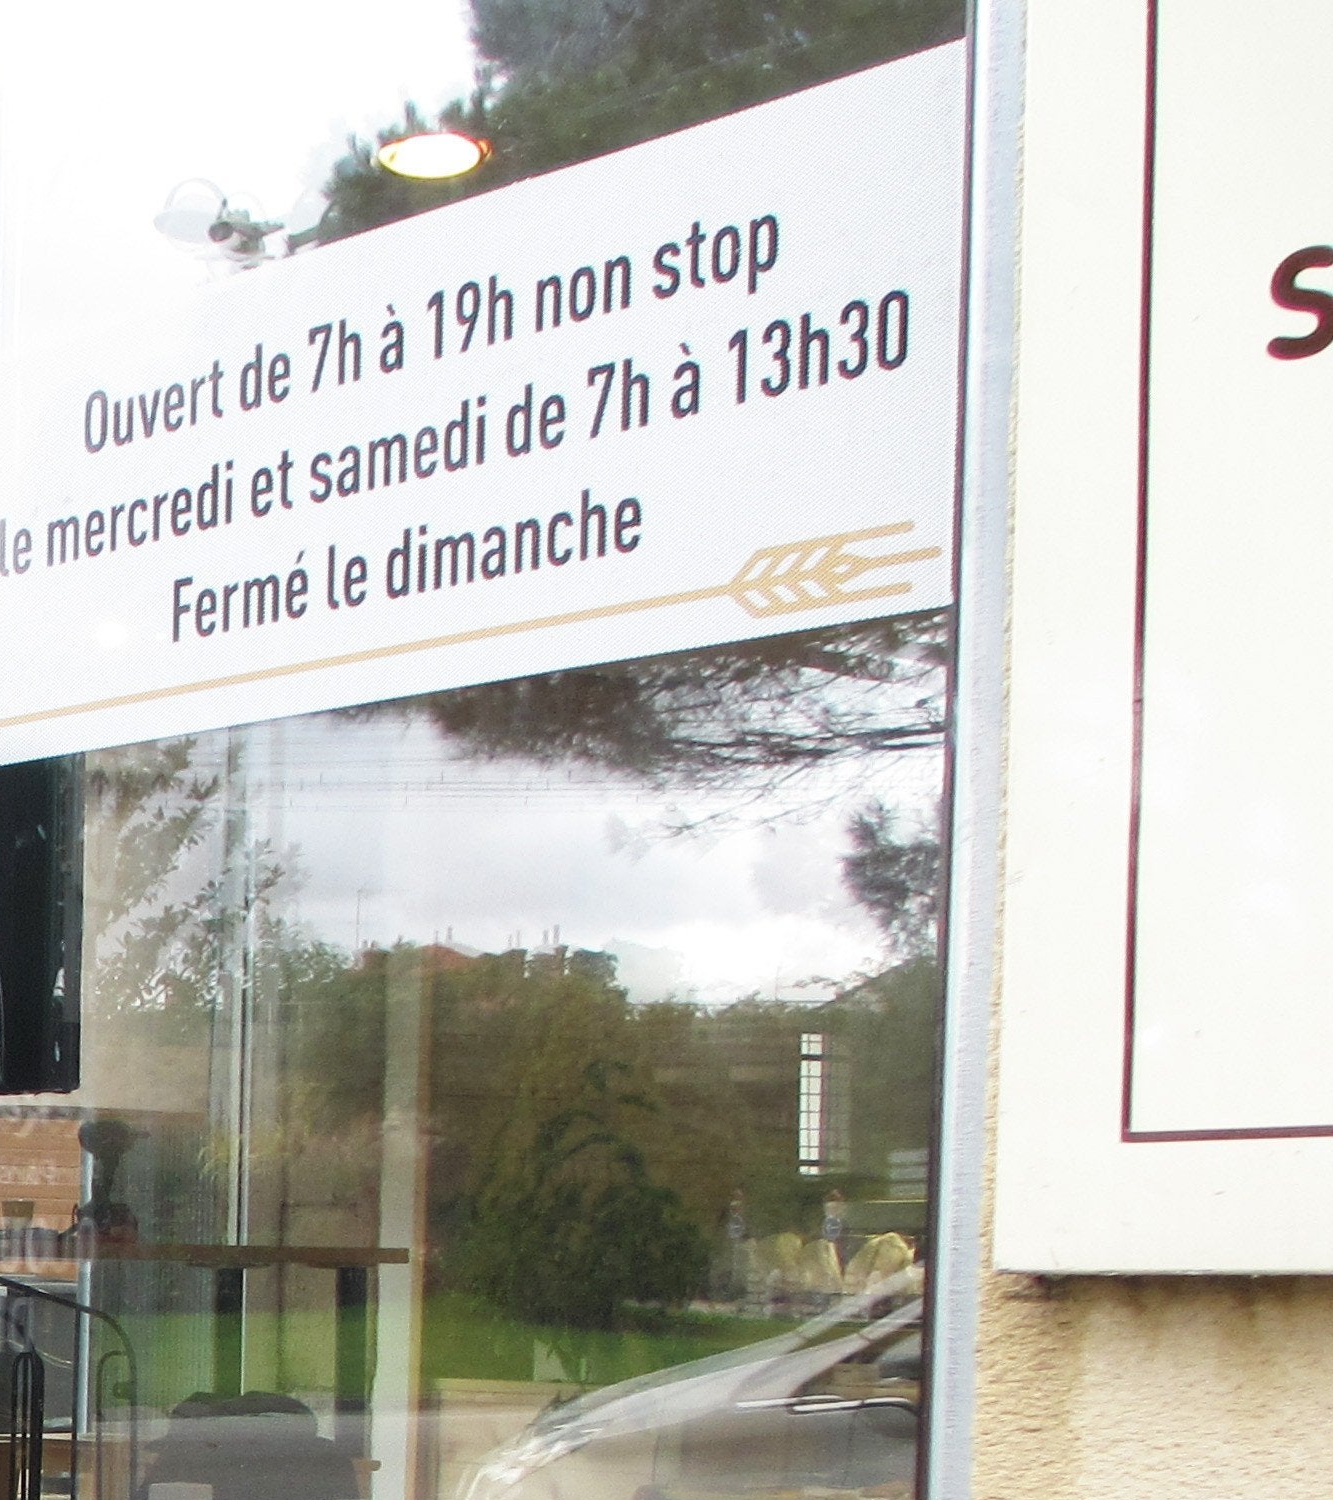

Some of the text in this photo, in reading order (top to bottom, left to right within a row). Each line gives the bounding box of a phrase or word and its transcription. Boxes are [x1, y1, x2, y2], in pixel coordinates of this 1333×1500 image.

[0, 287, 911, 578] le mercredi et samedi de 7h à 13h30
[84, 212, 780, 454] Ouvert de 7h à 19h non stop
[171, 487, 642, 643] Fermé le dimanche
